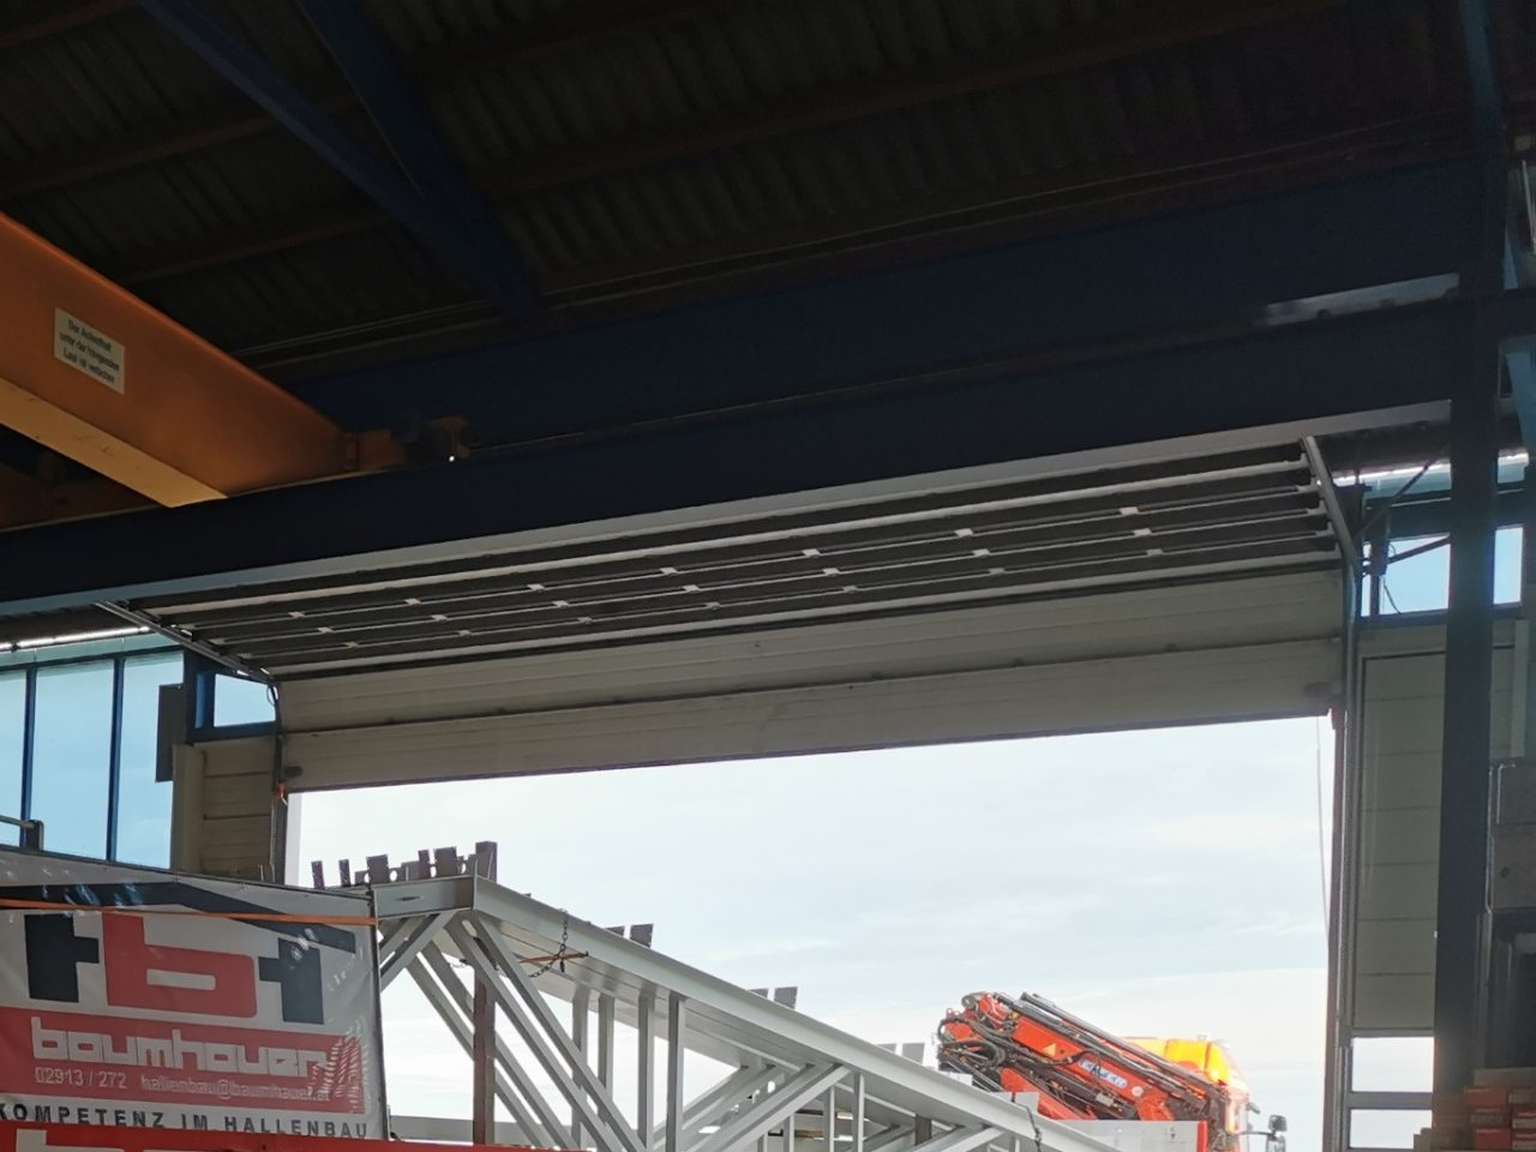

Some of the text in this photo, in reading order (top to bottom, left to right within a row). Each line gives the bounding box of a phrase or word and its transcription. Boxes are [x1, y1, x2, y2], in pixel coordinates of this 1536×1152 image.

[31, 1016, 328, 1078] baumhauer
[98, 1070, 128, 1089] 272
[181, 1113, 209, 1132] IM
[223, 1115, 368, 1138] HALLENBAU
